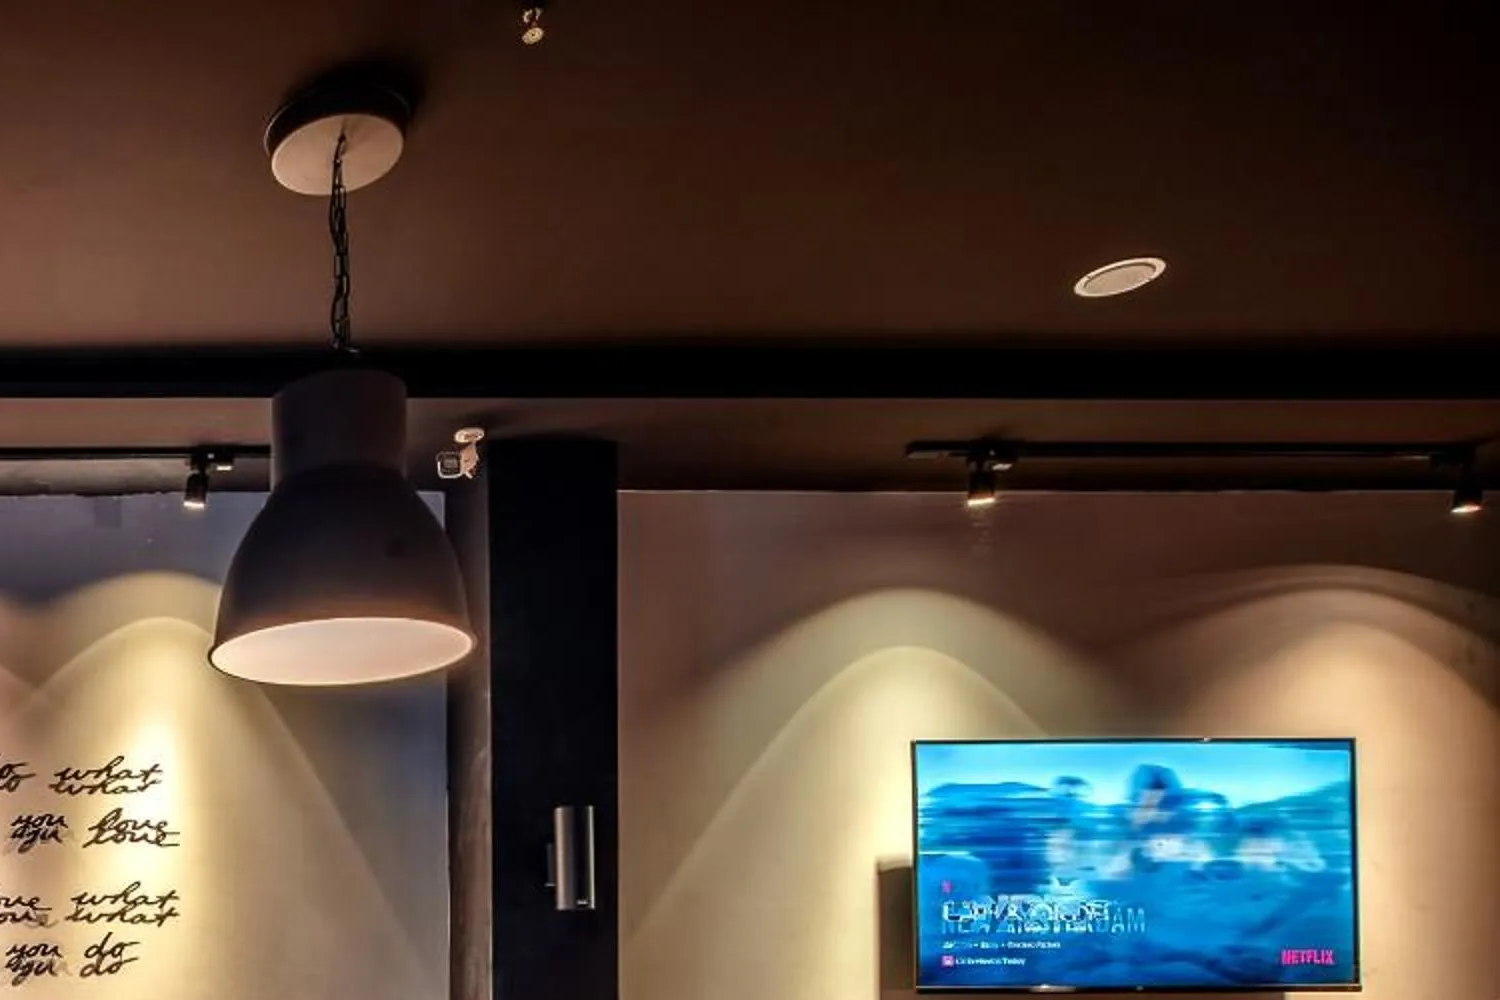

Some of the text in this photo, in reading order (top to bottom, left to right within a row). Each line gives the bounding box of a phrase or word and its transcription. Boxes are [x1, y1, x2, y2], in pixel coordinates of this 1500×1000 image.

[52, 756, 163, 782] what
[87, 807, 180, 836] love
[69, 881, 180, 908] what
[82, 932, 140, 960] do
[1282, 949, 1334, 966] NETFLIX
